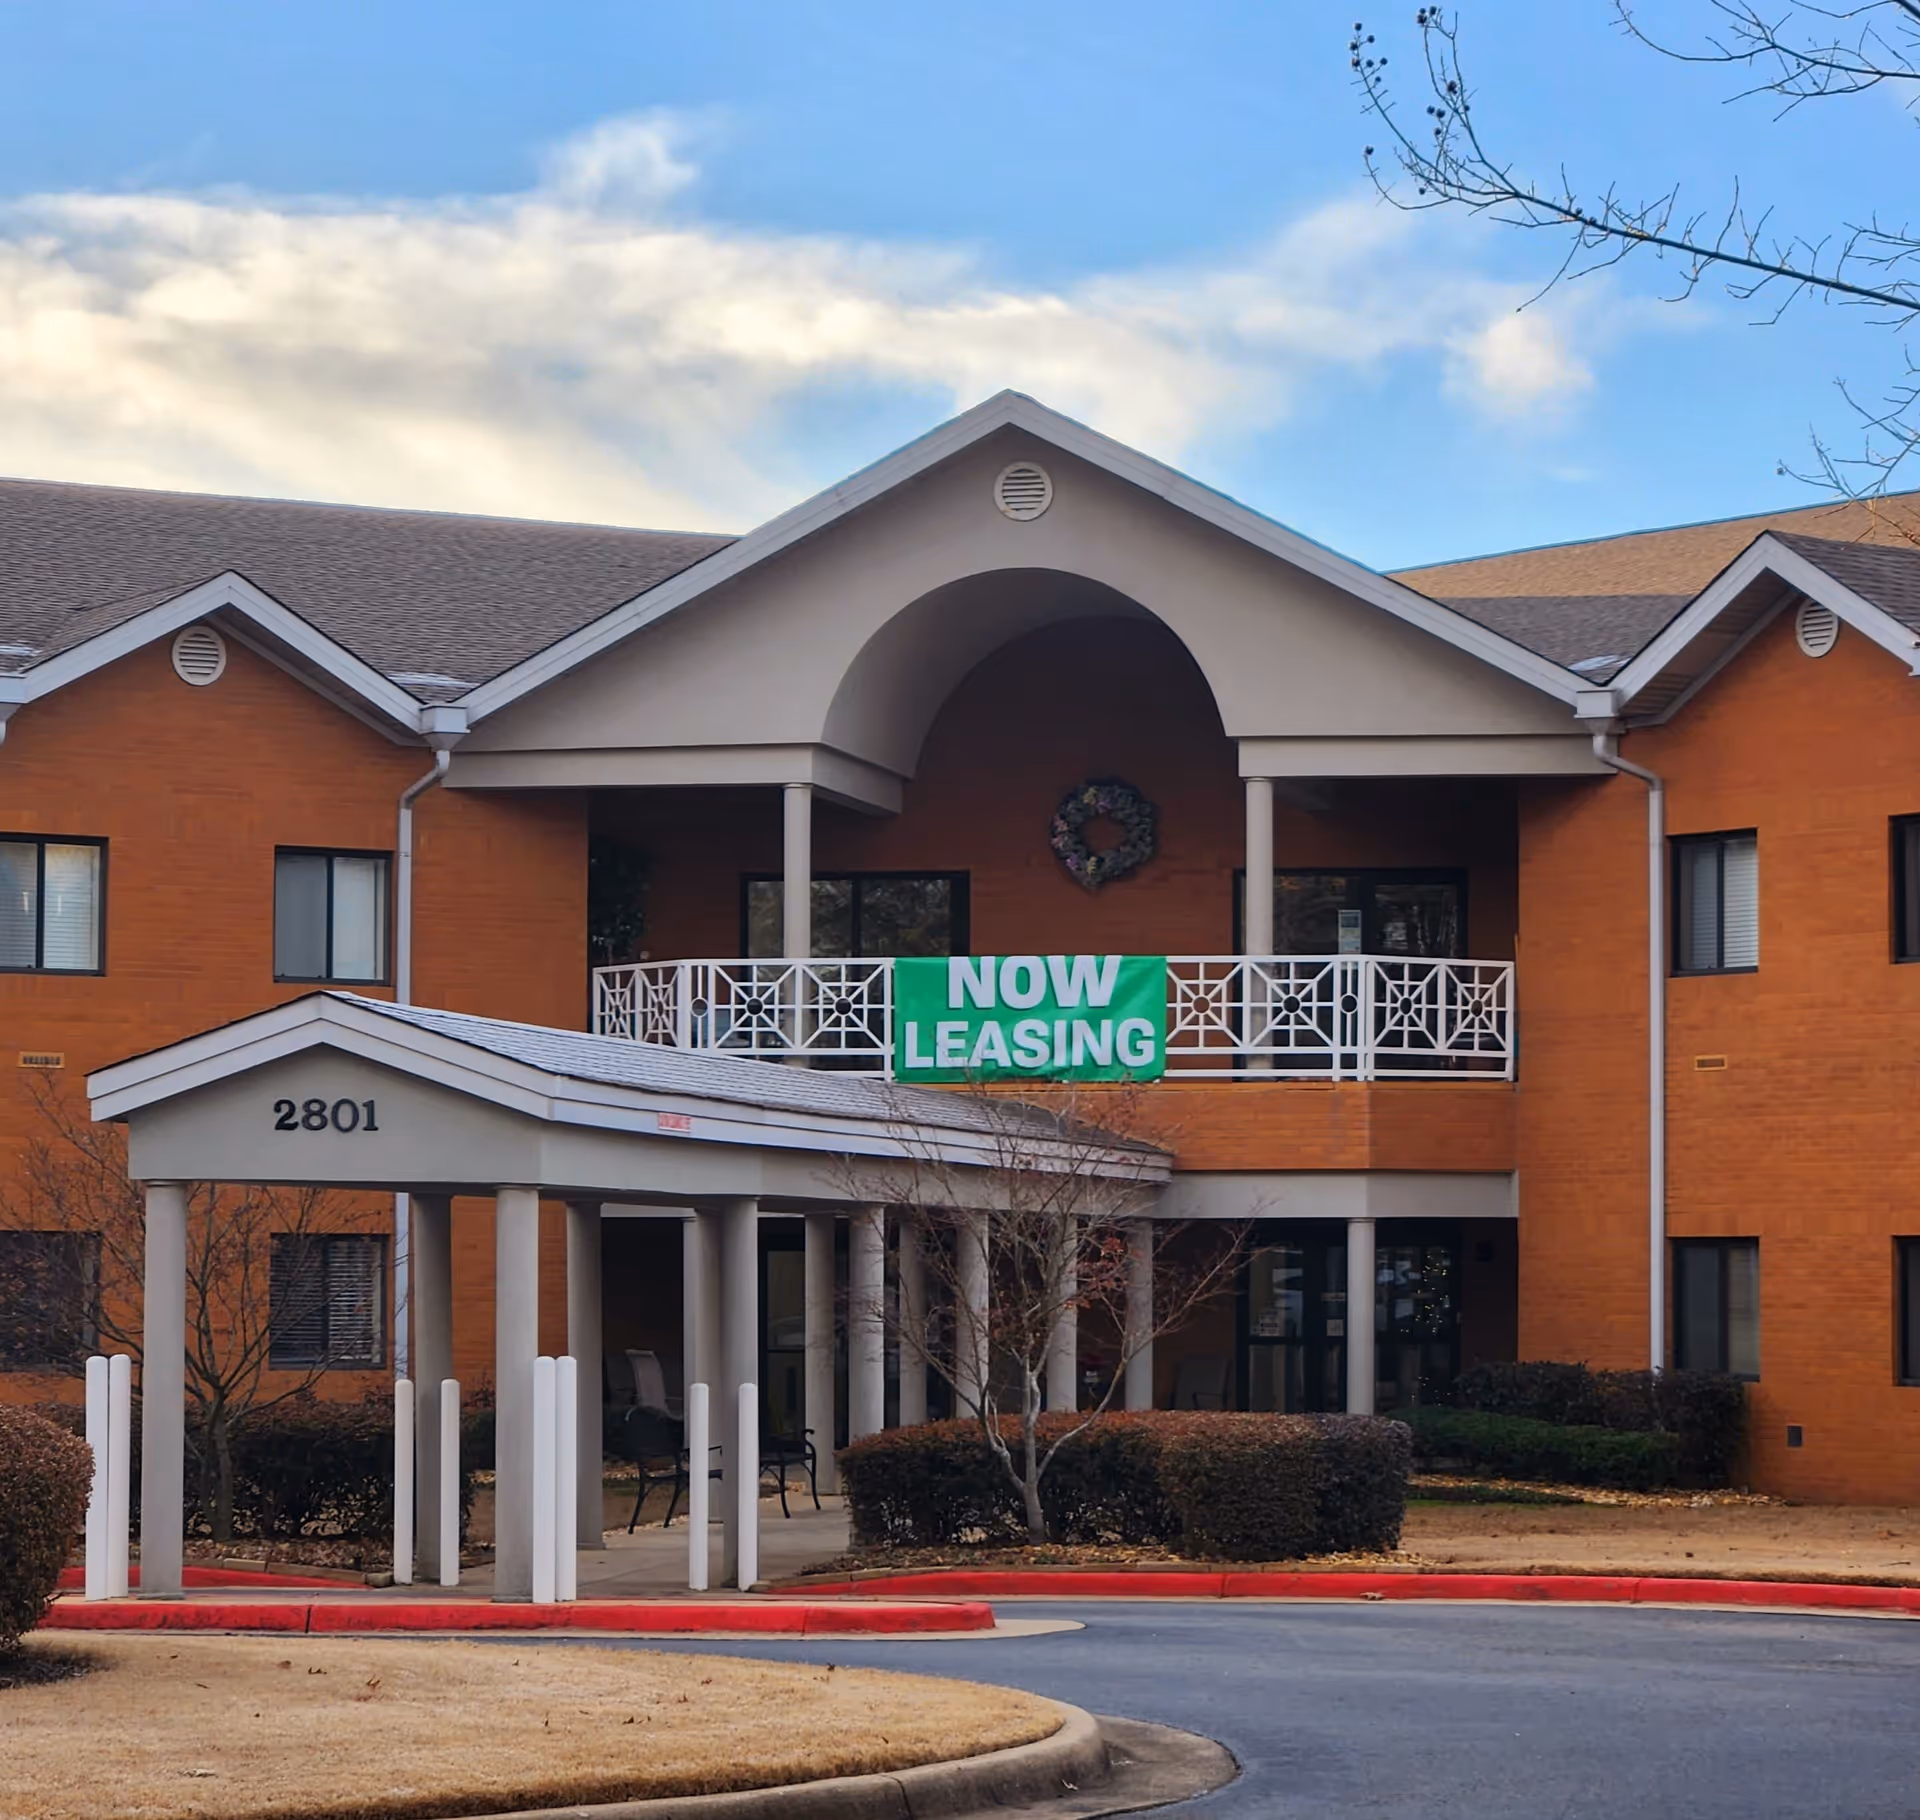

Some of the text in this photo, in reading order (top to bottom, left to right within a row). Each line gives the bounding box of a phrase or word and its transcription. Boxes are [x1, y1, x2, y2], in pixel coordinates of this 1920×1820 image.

[949, 955, 1122, 1009] NOW
[905, 1018, 1155, 1068] LEASING
[273, 1098, 379, 1133] 2801
